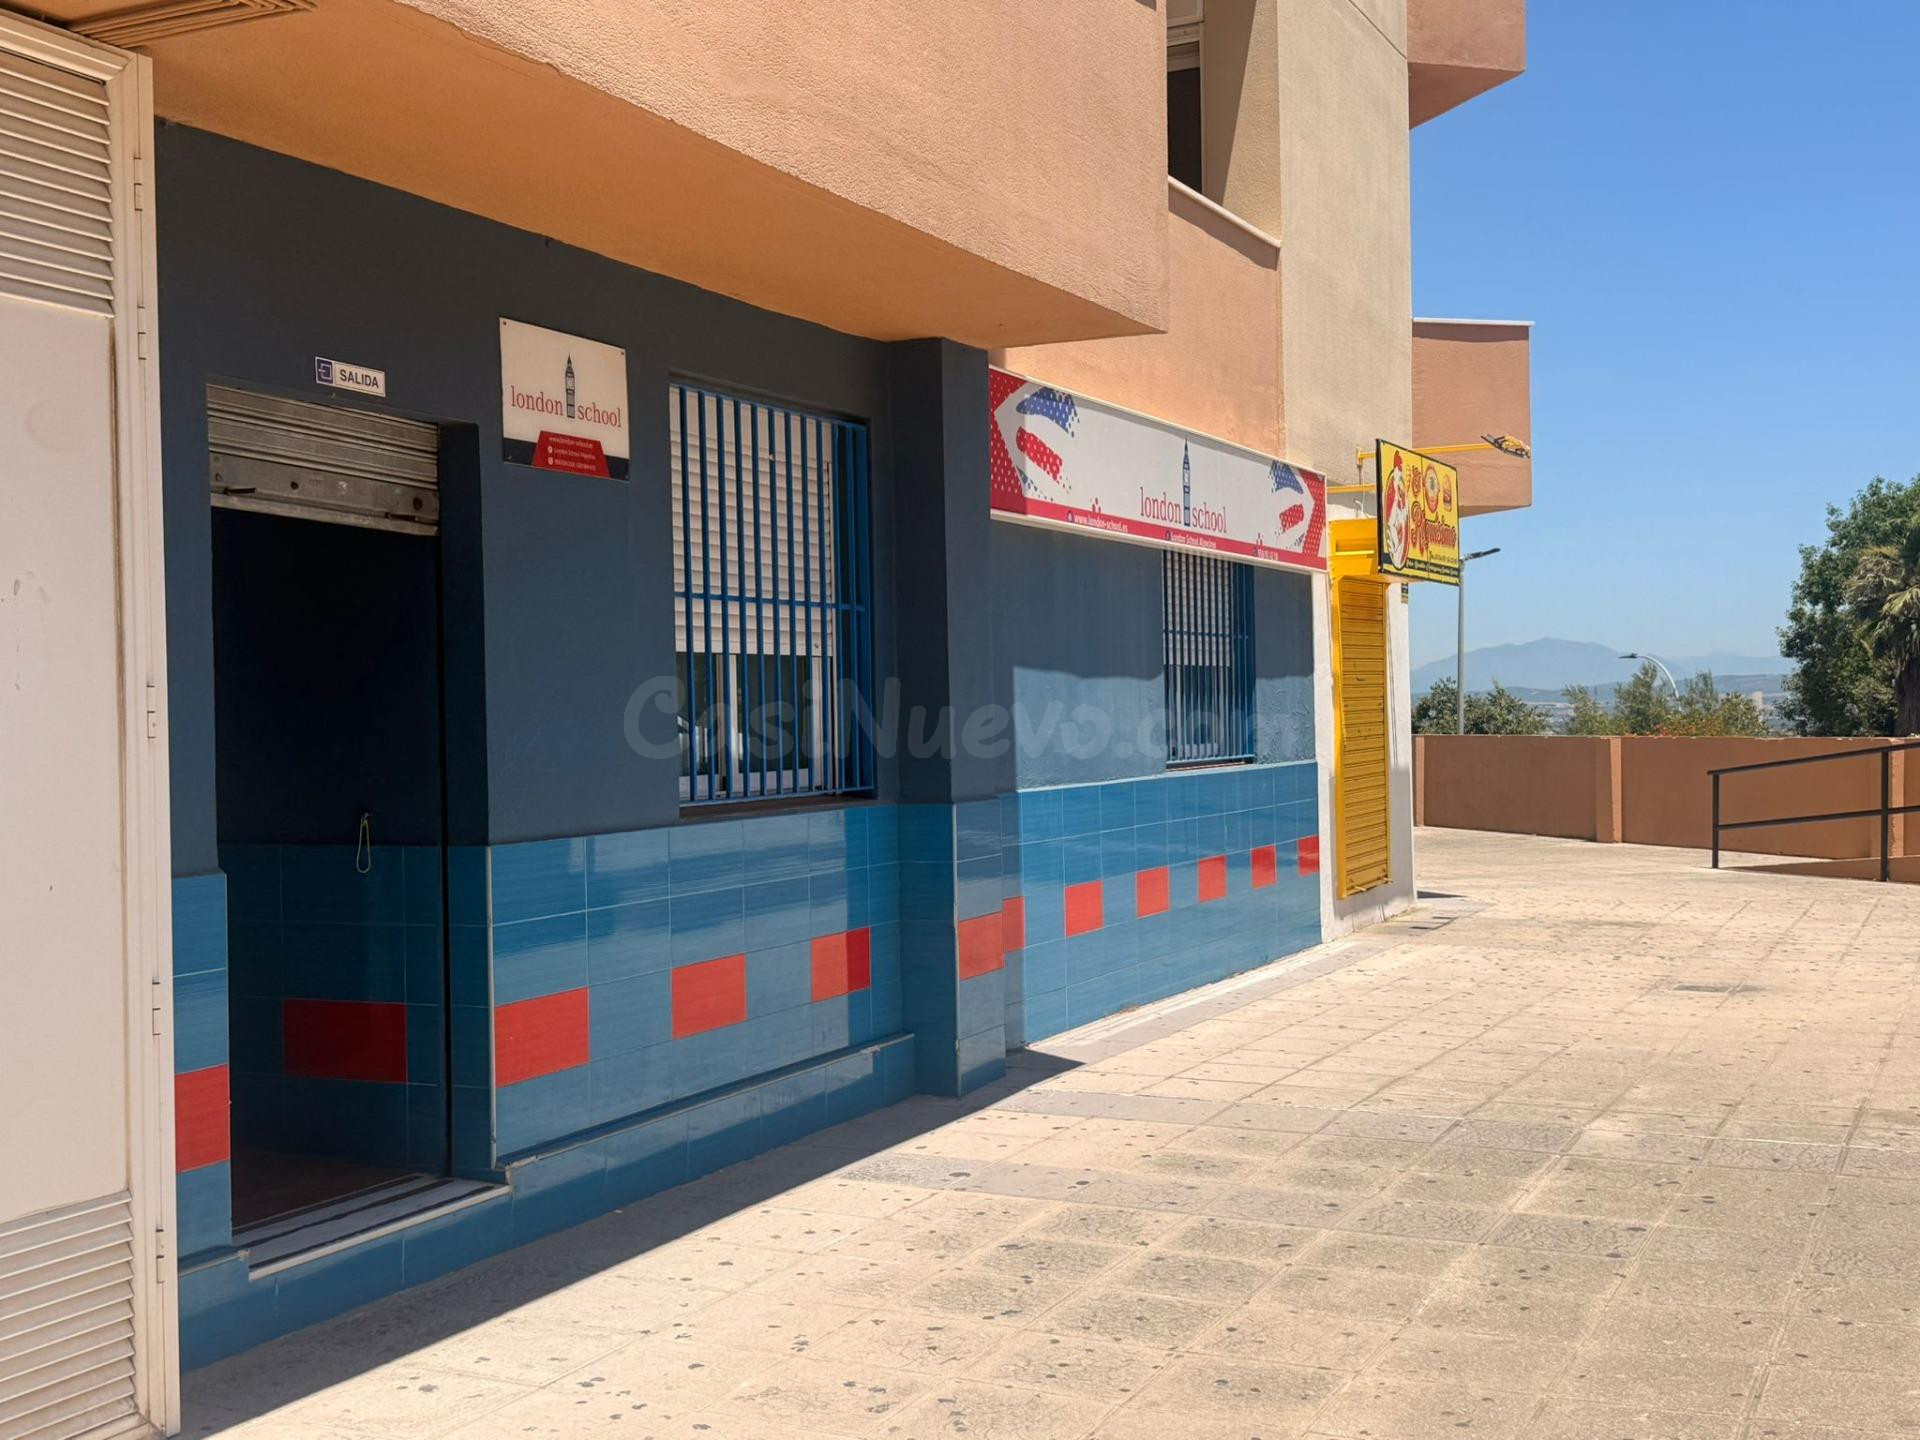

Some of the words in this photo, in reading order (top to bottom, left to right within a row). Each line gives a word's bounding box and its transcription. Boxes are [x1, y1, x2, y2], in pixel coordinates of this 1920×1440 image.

[339, 369, 379, 389] SALIDA
[510, 385, 564, 416] london
[577, 402, 622, 428] school
[1140, 486, 1182, 524] london
[1192, 501, 1227, 534] school
